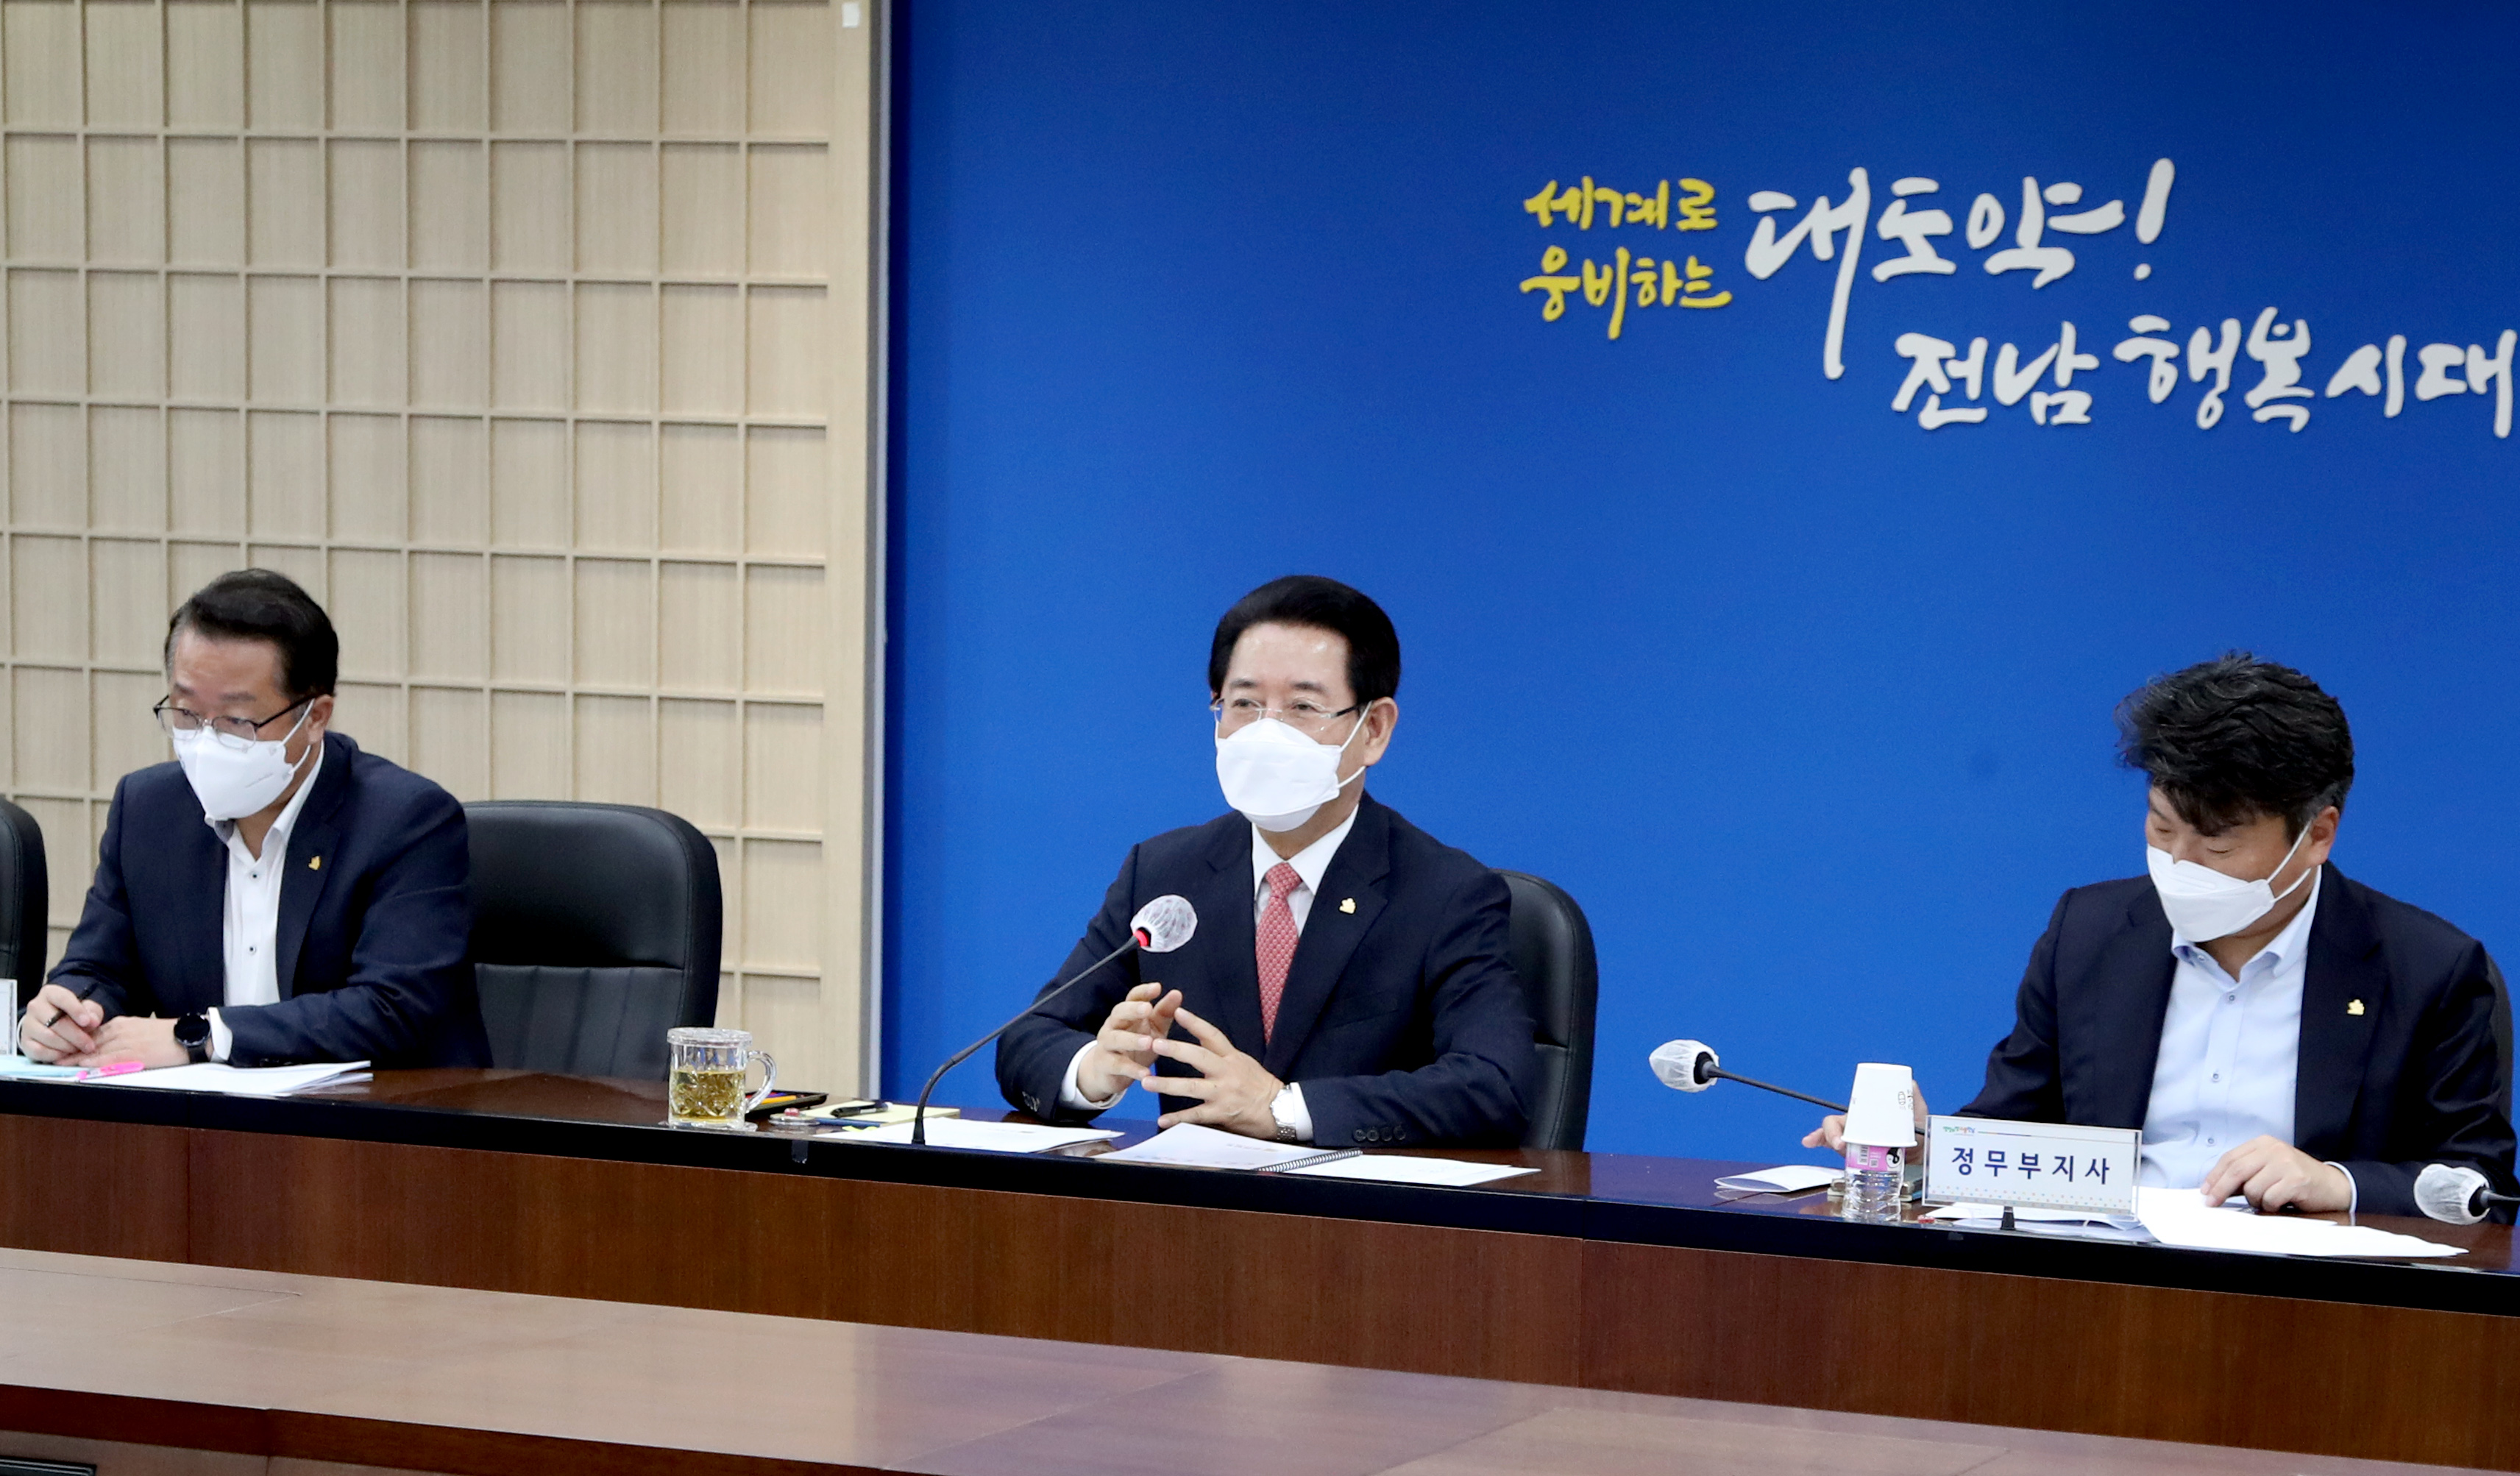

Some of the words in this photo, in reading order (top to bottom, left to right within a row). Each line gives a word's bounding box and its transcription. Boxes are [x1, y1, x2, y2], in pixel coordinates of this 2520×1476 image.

[1524, 175, 1718, 232] 세계로
[1519, 245, 1733, 340] 웅비하는
[1745, 158, 2175, 380] 대도약!
[1891, 321, 2100, 430] 전남
[1951, 1147, 2110, 1185] 정무부지사
